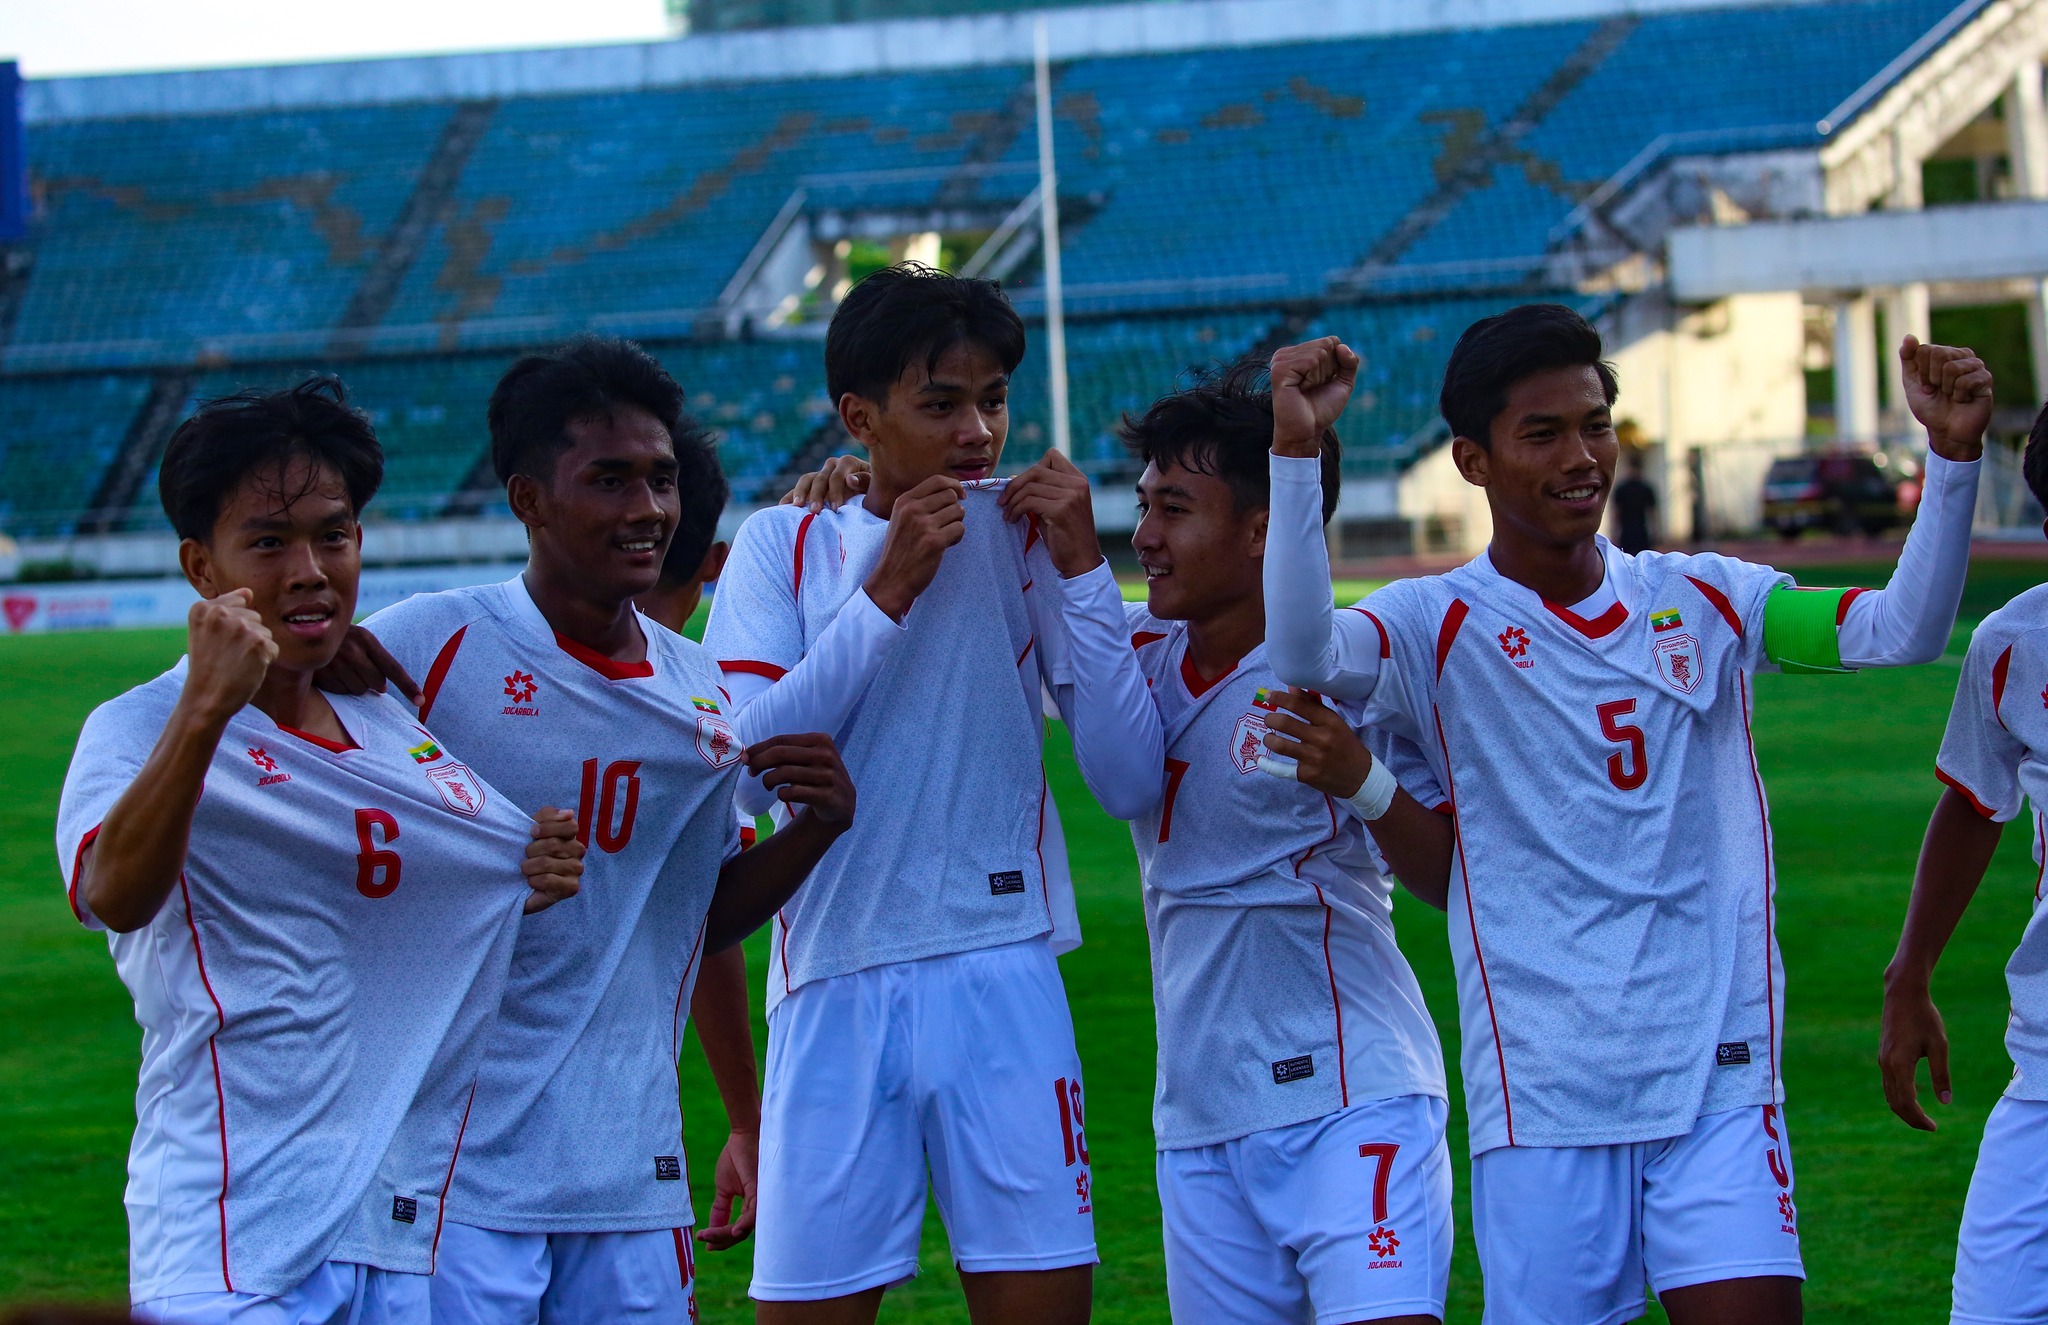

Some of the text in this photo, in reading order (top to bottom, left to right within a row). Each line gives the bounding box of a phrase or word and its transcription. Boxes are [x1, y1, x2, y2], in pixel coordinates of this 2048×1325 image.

[1595, 698, 1648, 791] 5
[575, 757, 643, 854] 10
[1158, 757, 1191, 844] 7
[354, 808, 402, 899] 6
[1358, 1143, 1401, 1225] 7
[1762, 1104, 1789, 1189] 5
